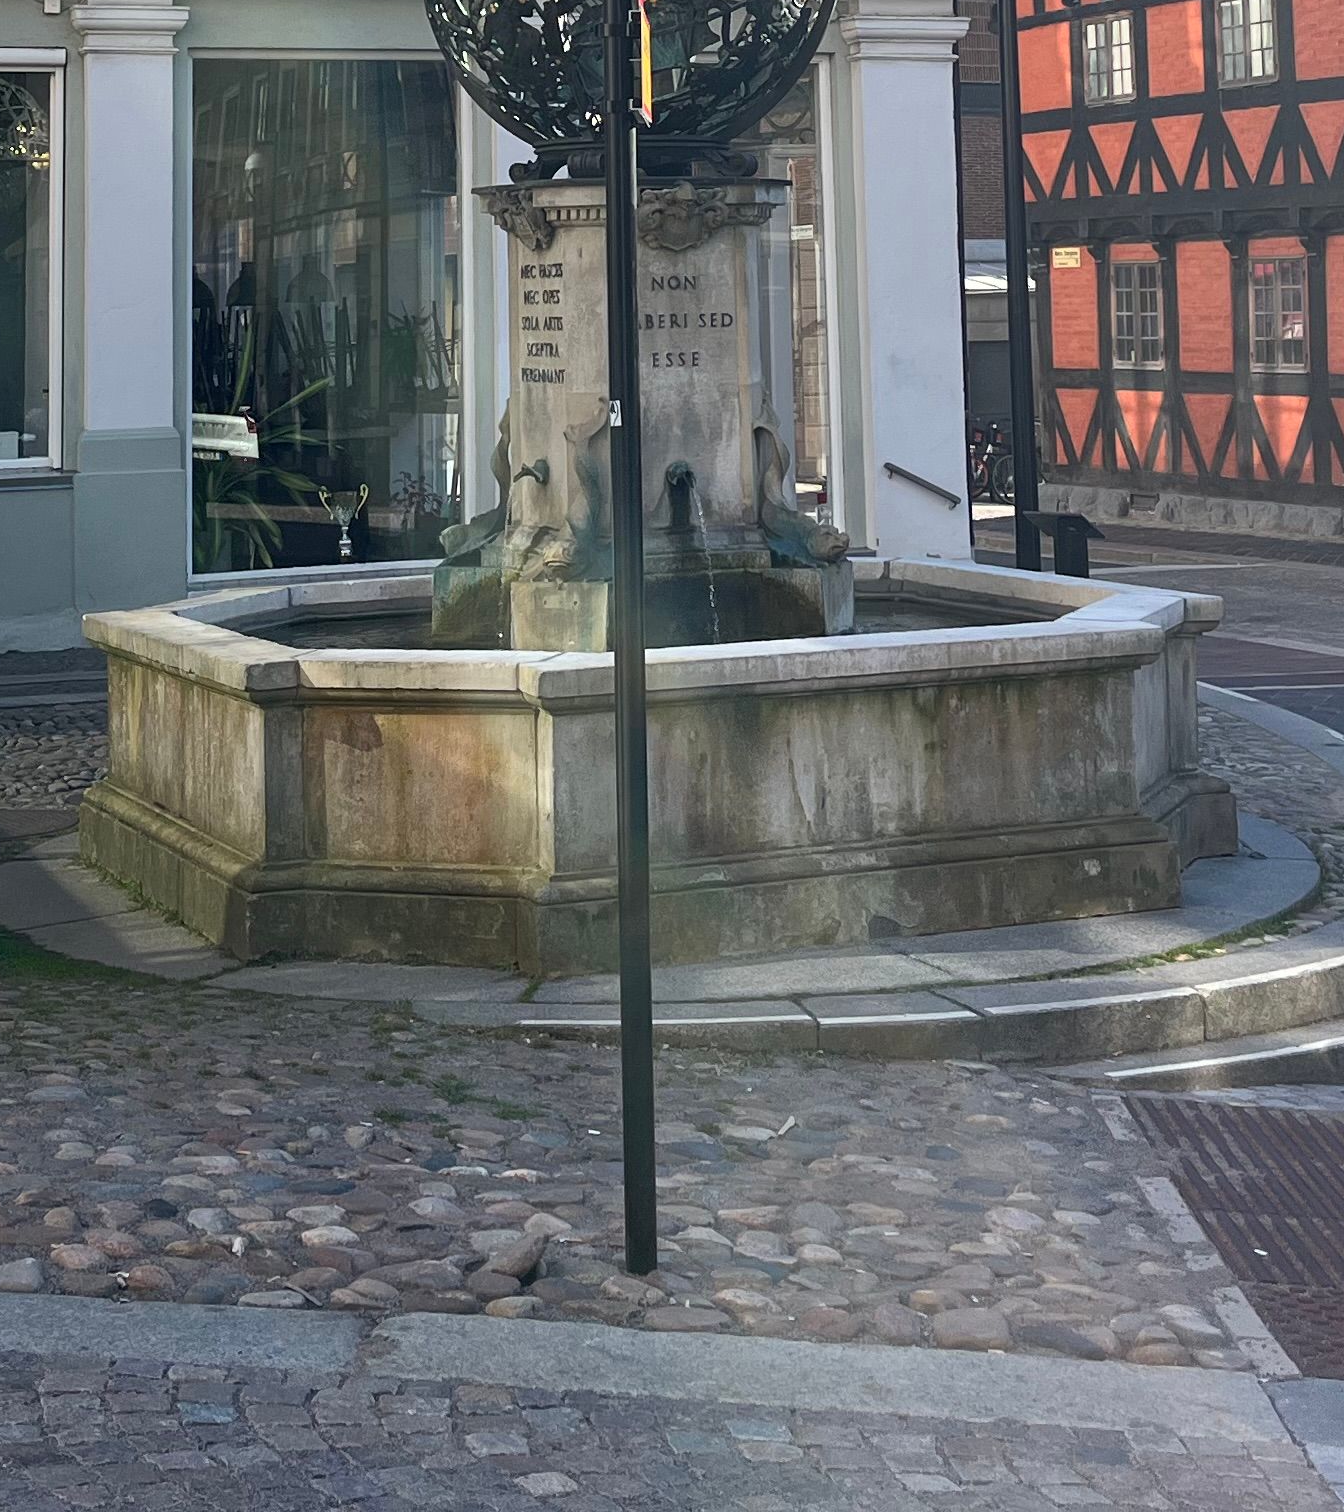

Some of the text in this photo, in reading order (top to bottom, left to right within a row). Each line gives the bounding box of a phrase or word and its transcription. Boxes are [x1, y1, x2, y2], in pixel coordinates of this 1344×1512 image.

[521, 264, 536, 279] NEC
[651, 275, 697, 291] NON
[524, 289, 560, 305] NEC OPES
[522, 316, 540, 331] SOLA
[639, 312, 733, 330] BERI SED
[527, 342, 560, 358] SCEPTRA
[651, 351, 699, 368] ESSE
